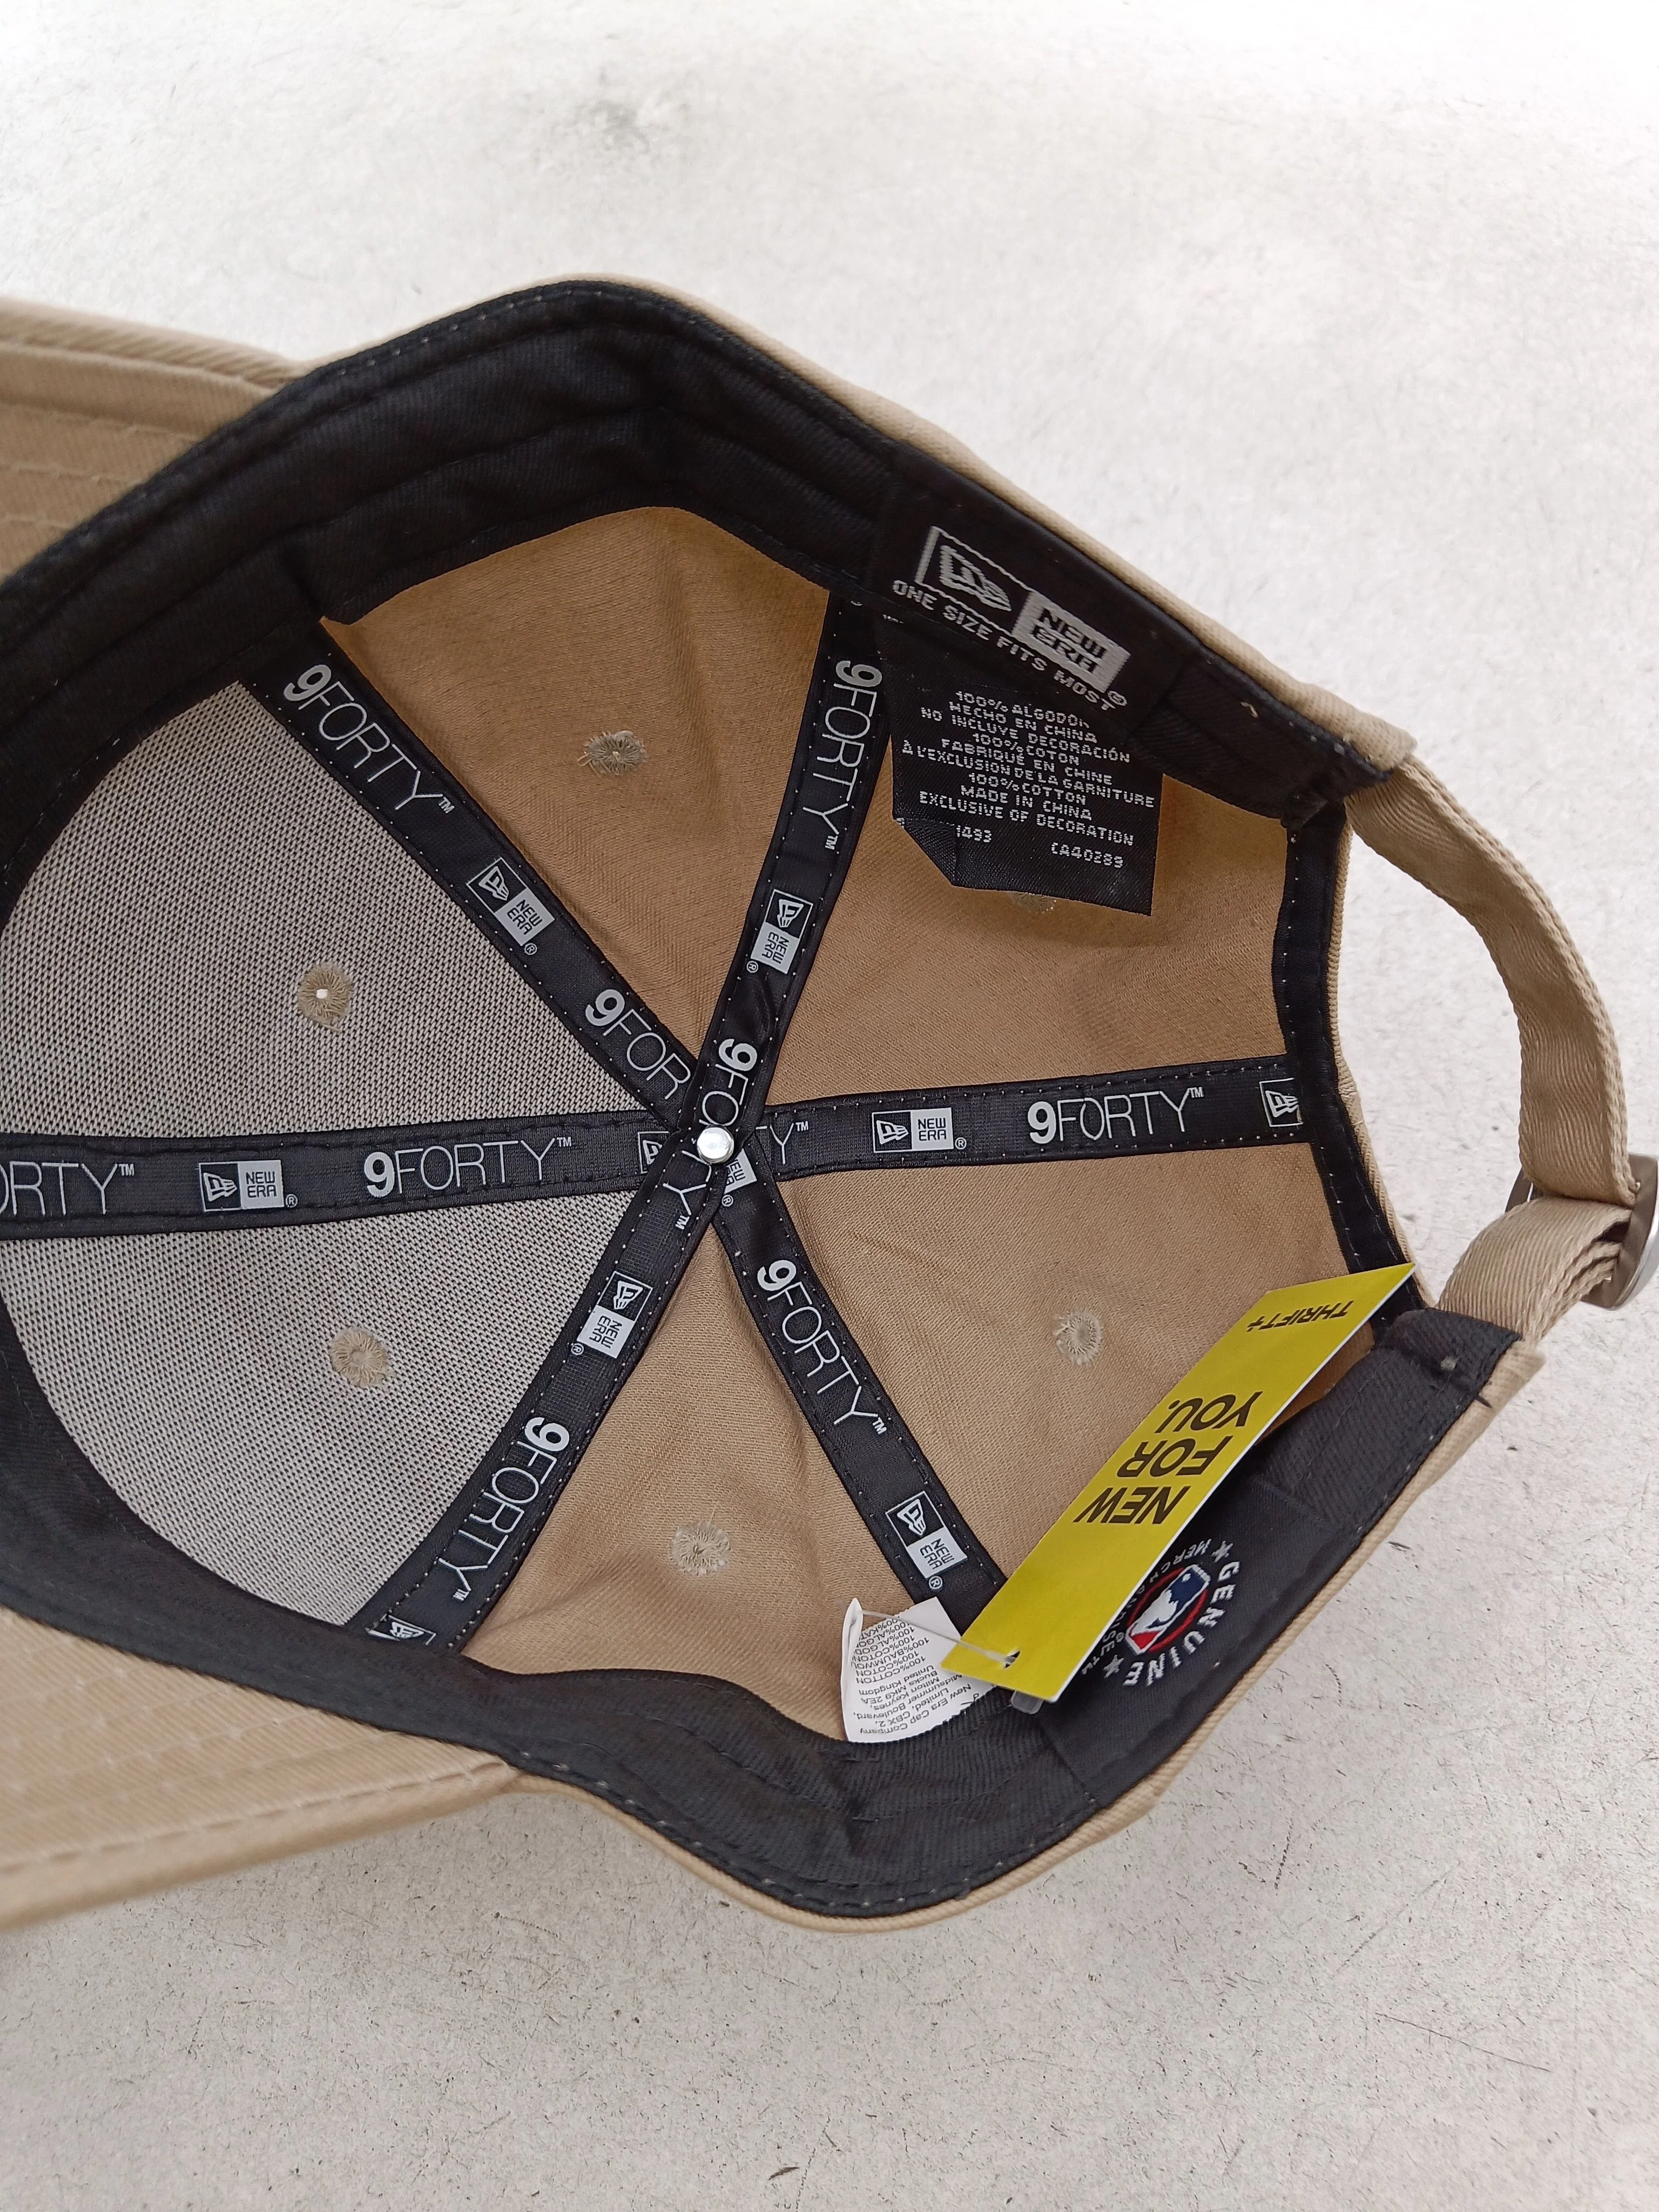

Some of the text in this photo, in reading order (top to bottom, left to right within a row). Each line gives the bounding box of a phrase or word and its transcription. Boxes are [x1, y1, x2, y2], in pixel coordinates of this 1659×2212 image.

[892, 579, 1116, 711] ONE SIZE FITS MOST
[1038, 606, 1107, 659] NEW
[1032, 625, 1098, 675] ERA
[921, 707, 1130, 763] NO INCLUYE DECORACIÓN
[949, 702, 1097, 744] HECHO EN CHINA
[941, 738, 1112, 785] FABRIQUÉ EN CHINE
[961, 785, 1092, 821] MADE IN CHINA
[1062, 778, 1155, 808] GARNITURE
[920, 791, 1134, 846] EXCLUSIVE OF DECORATION
[956, 825, 992, 843] 1493
[507, 908, 533, 935] ERA
[516, 899, 543, 927] NEW
[761, 932, 779, 959] ERA
[771, 939, 790, 965] NEW
[918, 1118, 946, 1130] NEW
[918, 1129, 947, 1141] ERA
[246, 1171, 276, 1183] NEW
[247, 1185, 277, 1198] ERA
[589, 1315, 611, 1343] ERA
[1246, 1300, 1354, 1332] THRIFT+
[601, 1319, 623, 1349] NEW
[1154, 1391, 1263, 1433] YOU.
[1116, 1435, 1233, 1478] FOR
[1072, 1486, 1191, 1525] NEW
[919, 1545, 943, 1570] ERA
[930, 1538, 954, 1563] NEW
[1123, 1561, 1240, 1686] GENUINE
[852, 1635, 915, 1662] 100%COTON
[853, 1626, 915, 1655] 100%ALGOD
[856, 1650, 919, 1676] 100%COTON
[856, 1656, 926, 1684] 100%COTTON
[859, 1665, 934, 1695] United Kingdom
[860, 1670, 938, 1704] Bucks MK9 2EA
[908, 1674, 963, 1705] Midsummer
[911, 1676, 940, 1692] Milton
[950, 1683, 972, 1700] New
[890, 1711, 911, 1725] CBX
[910, 1709, 929, 1724] Cap
[930, 1697, 949, 1711] Era
[860, 1723, 908, 1734] Company
